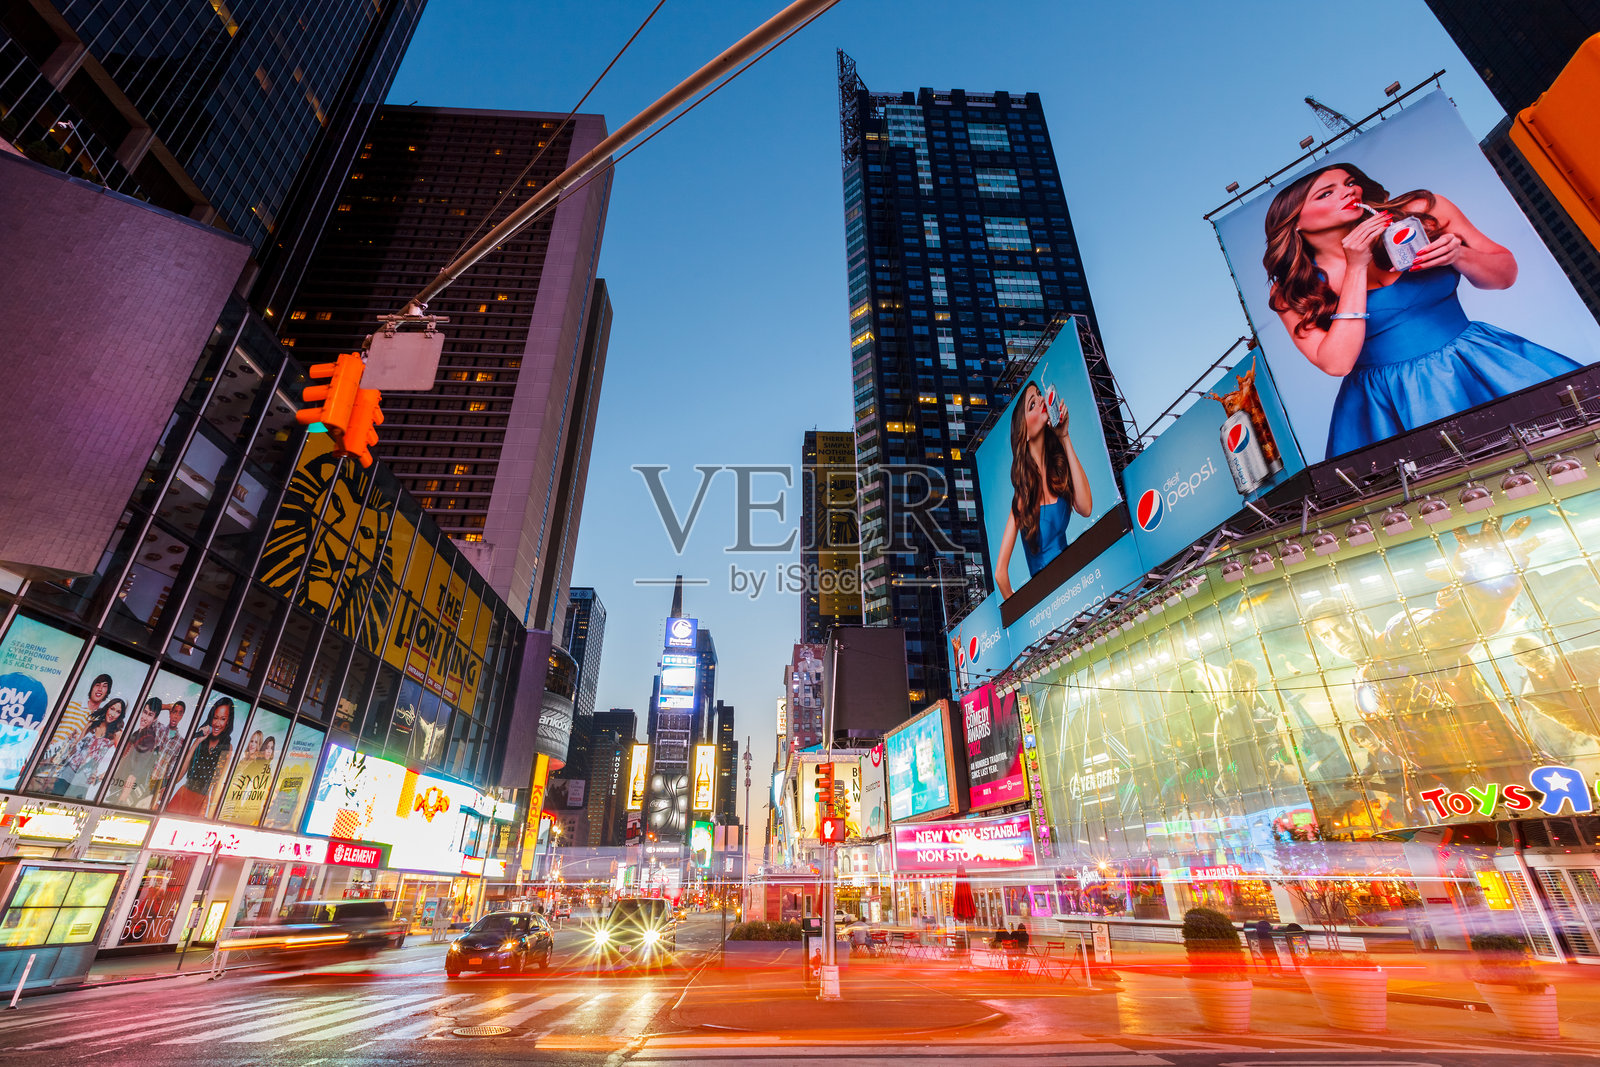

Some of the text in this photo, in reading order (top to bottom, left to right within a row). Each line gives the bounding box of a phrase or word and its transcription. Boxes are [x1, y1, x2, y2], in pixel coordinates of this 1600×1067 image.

[1163, 472, 1180, 492] diet
[1166, 457, 1216, 512] pepsi
[436, 583, 461, 623] THE
[1029, 568, 1101, 630] nothing refreshes like a
[394, 589, 443, 660] LION
[11, 640, 47, 653] STARRING
[981, 627, 1001, 654] pepsi
[6, 652, 33, 663] MILLER
[437, 626, 477, 687] KING
[3, 659, 62, 676] AS KACEY SIMON
[0, 686, 32, 706] ow
[1, 703, 25, 720] to
[965, 701, 975, 715] THE
[965, 706, 989, 729] COMEDY
[1021, 696, 1032, 733] TOYS
[539, 715, 572, 732] ankoo
[967, 721, 991, 743] AWARDS
[968, 741, 982, 757] 2012
[970, 762, 975, 770] AN
[1029, 750, 1039, 770] US
[612, 757, 621, 796] NOVOTEL
[971, 770, 981, 779] SINCE
[1033, 774, 1046, 824] BABIES
[526, 784, 543, 839] Kodak
[916, 824, 1021, 843] NEW YORK-ISTANBUL
[343, 848, 377, 864] ELEMENT
[917, 850, 945, 863] NON
[1042, 838, 1051, 856] US
[128, 899, 178, 919] BILLA
